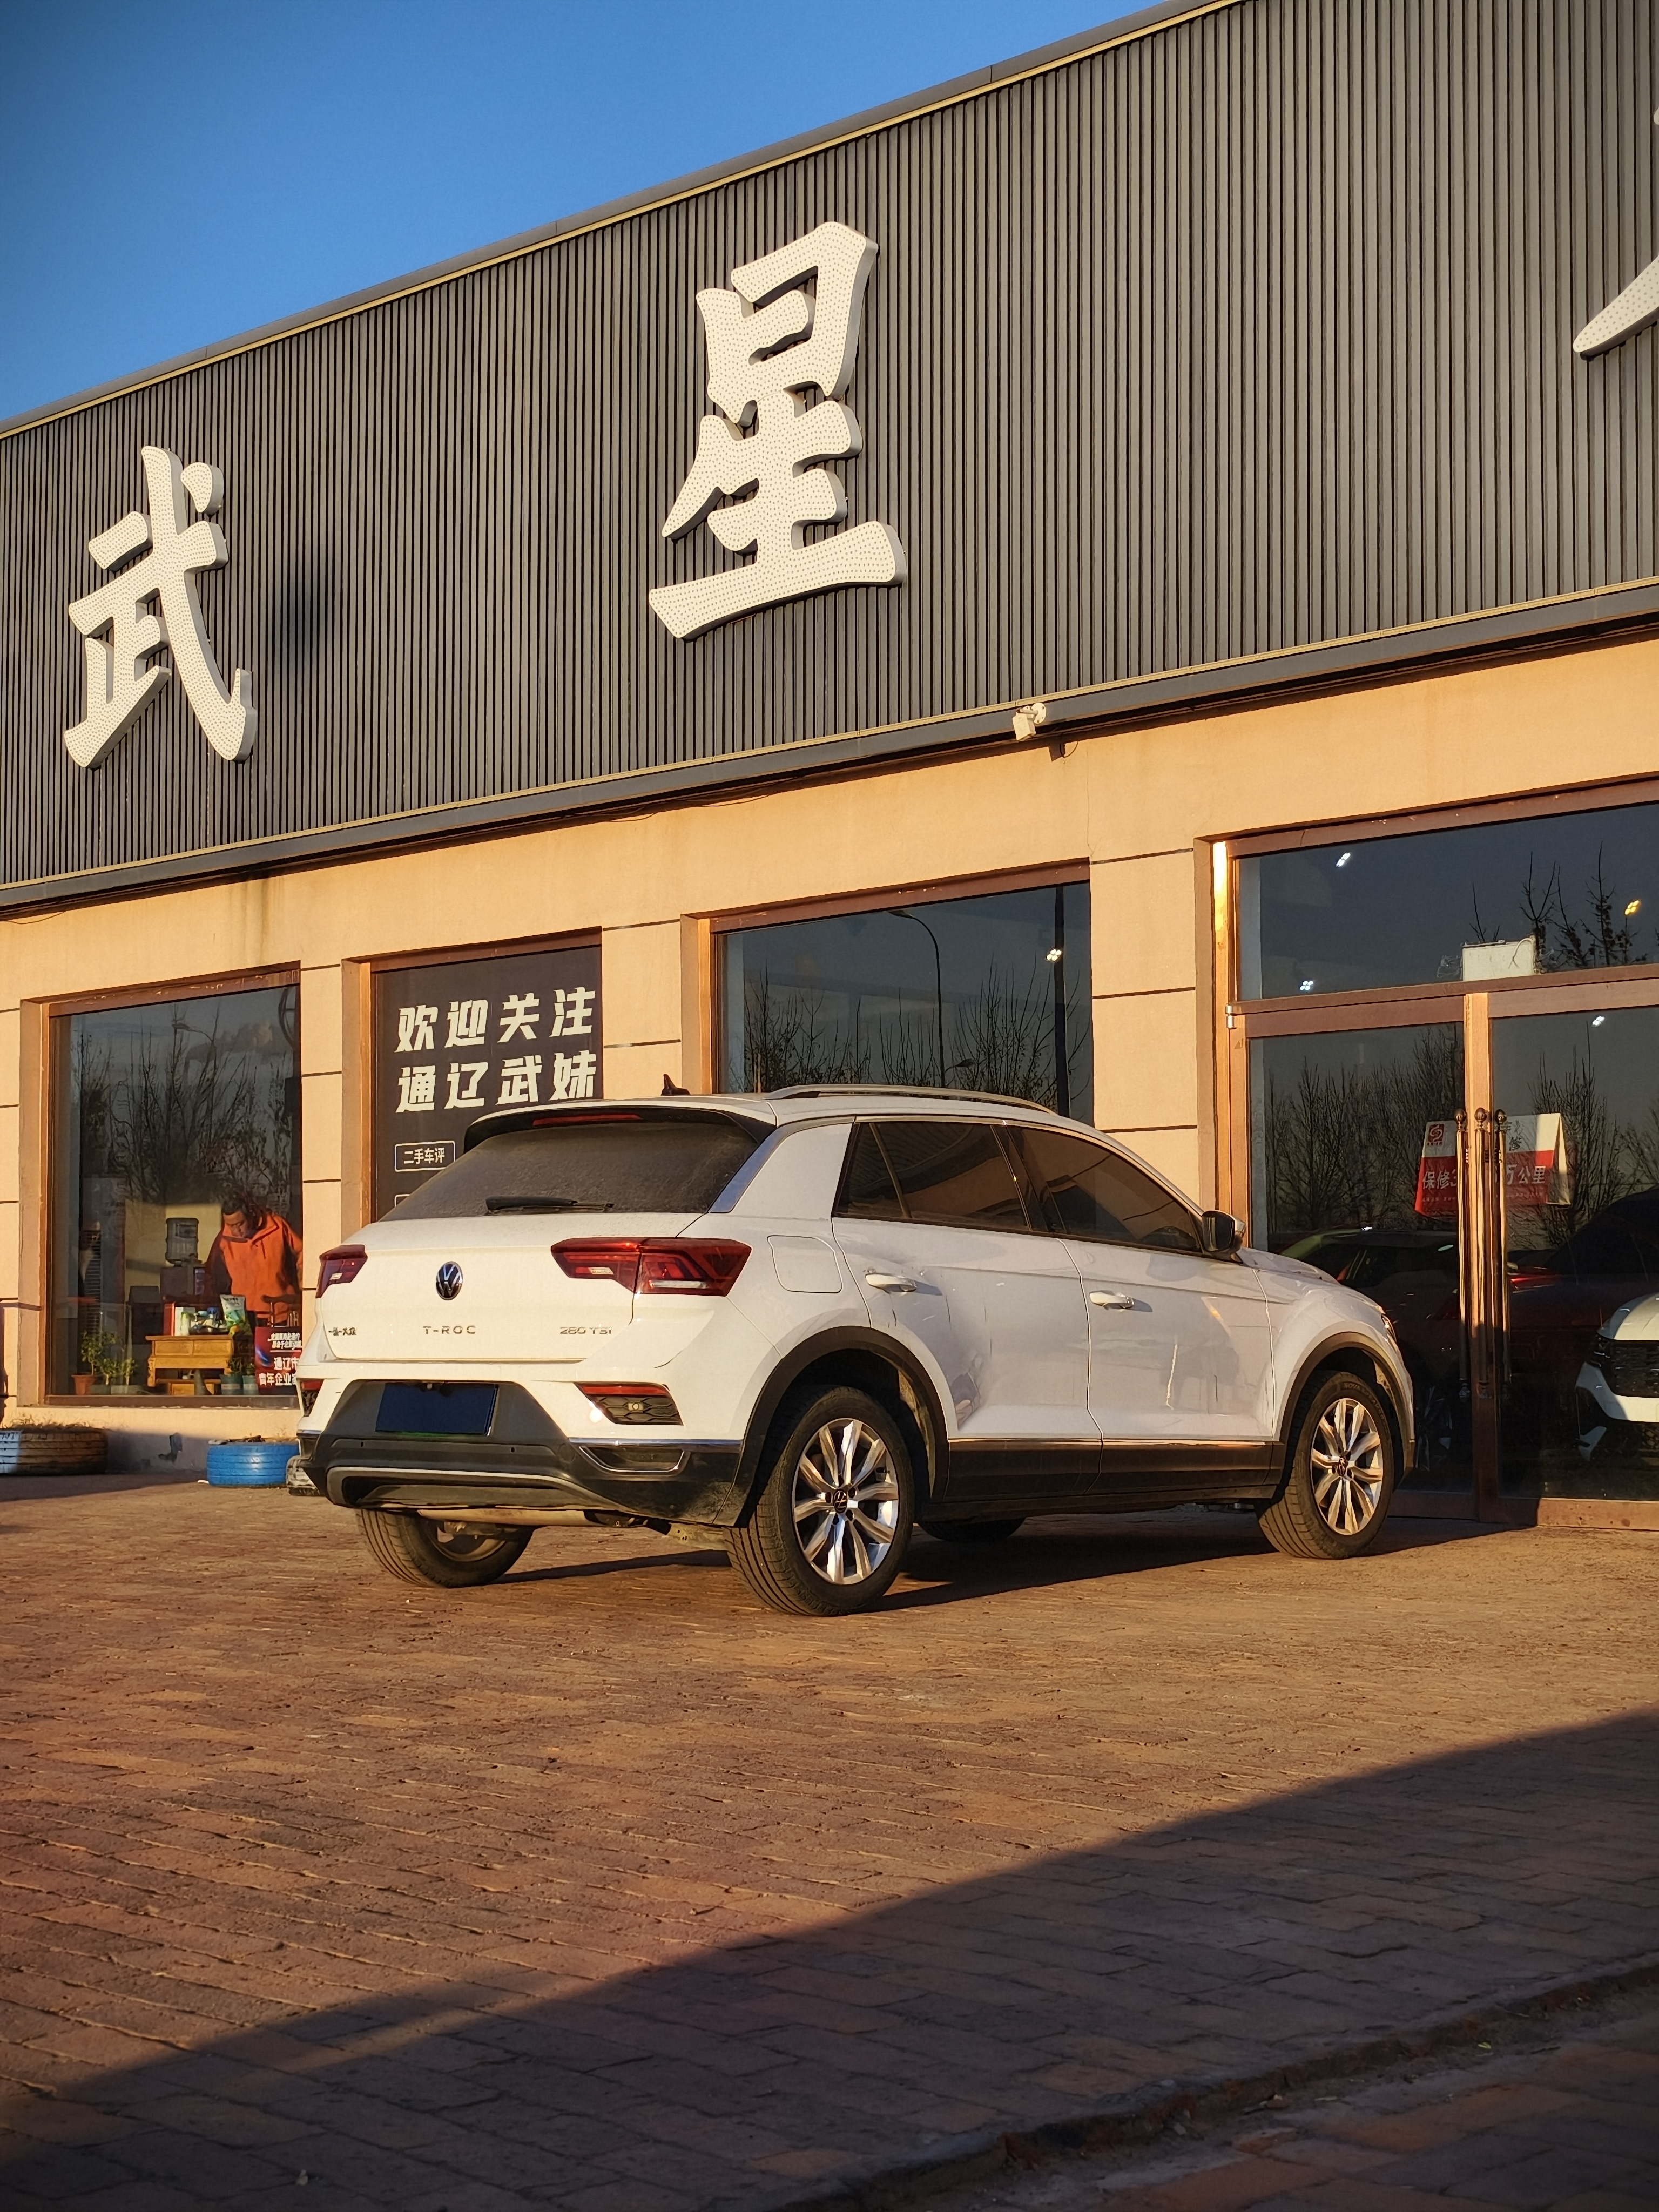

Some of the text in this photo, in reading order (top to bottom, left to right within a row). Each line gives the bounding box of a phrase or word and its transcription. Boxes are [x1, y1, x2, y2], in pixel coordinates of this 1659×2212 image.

[394, 987, 596, 1053] 欢迎关注
[395, 1050, 597, 1113] 通辽武妹
[404, 1147, 445, 1165] 二手车评
[423, 1325, 476, 1334] T-ROC
[559, 1326, 586, 1334] 280
